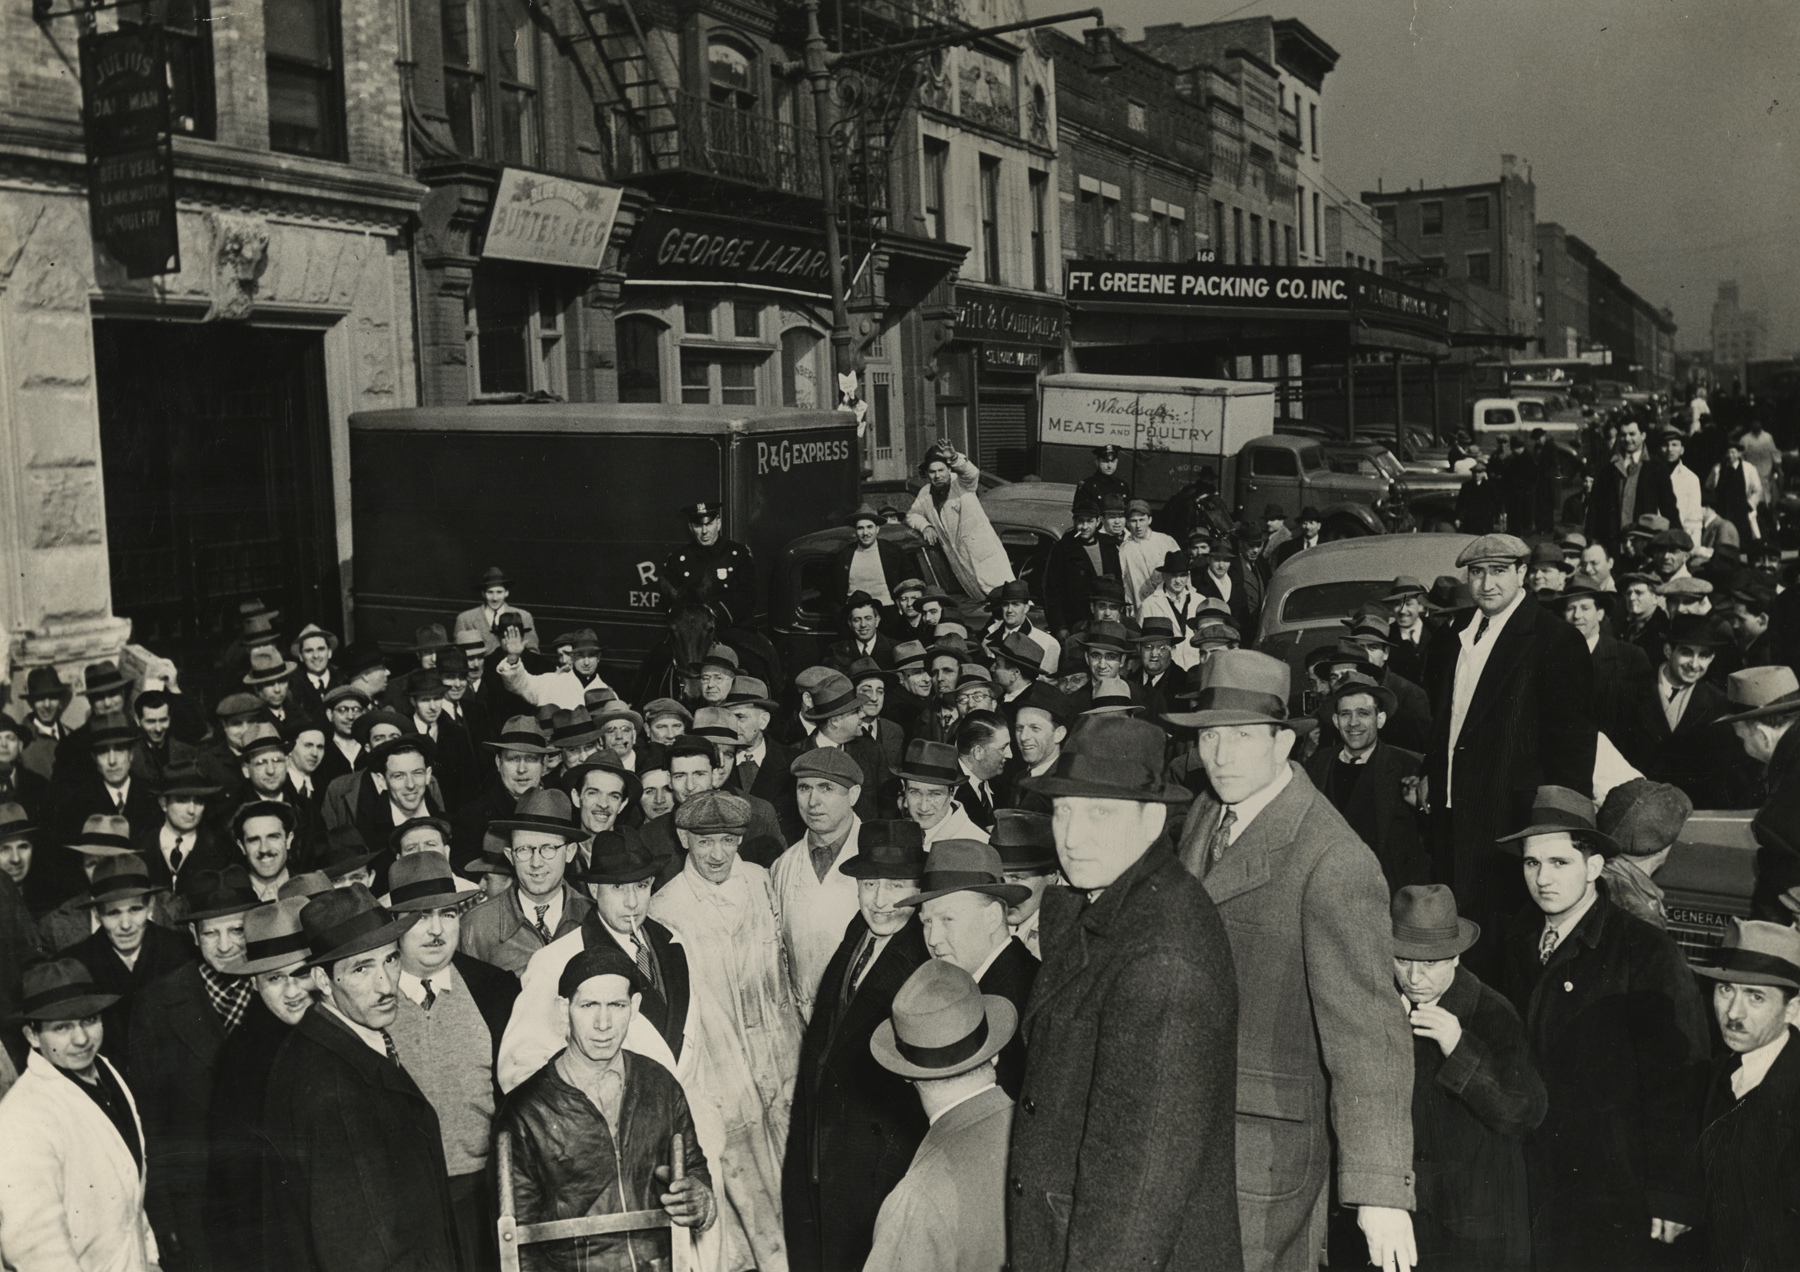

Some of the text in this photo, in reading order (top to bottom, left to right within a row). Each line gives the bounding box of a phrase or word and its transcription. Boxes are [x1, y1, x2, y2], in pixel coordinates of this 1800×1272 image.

[96, 52, 153, 86] JULIUS
[491, 205, 561, 244] BUTTER
[657, 227, 755, 268] GEORGE
[1196, 252, 1215, 263] 168
[1069, 271, 1095, 292] FT.
[1099, 272, 1176, 295] GREENE
[1181, 275, 1269, 298] PACKING
[1311, 279, 1348, 301] INC.
[955, 300, 984, 329] wift
[987, 303, 998, 330] &
[1048, 416, 1214, 442] MEATS AND POULTRY
[636, 560, 659, 586] R
[629, 590, 661, 608] EXP
[1673, 909, 1729, 927] GENERAL
